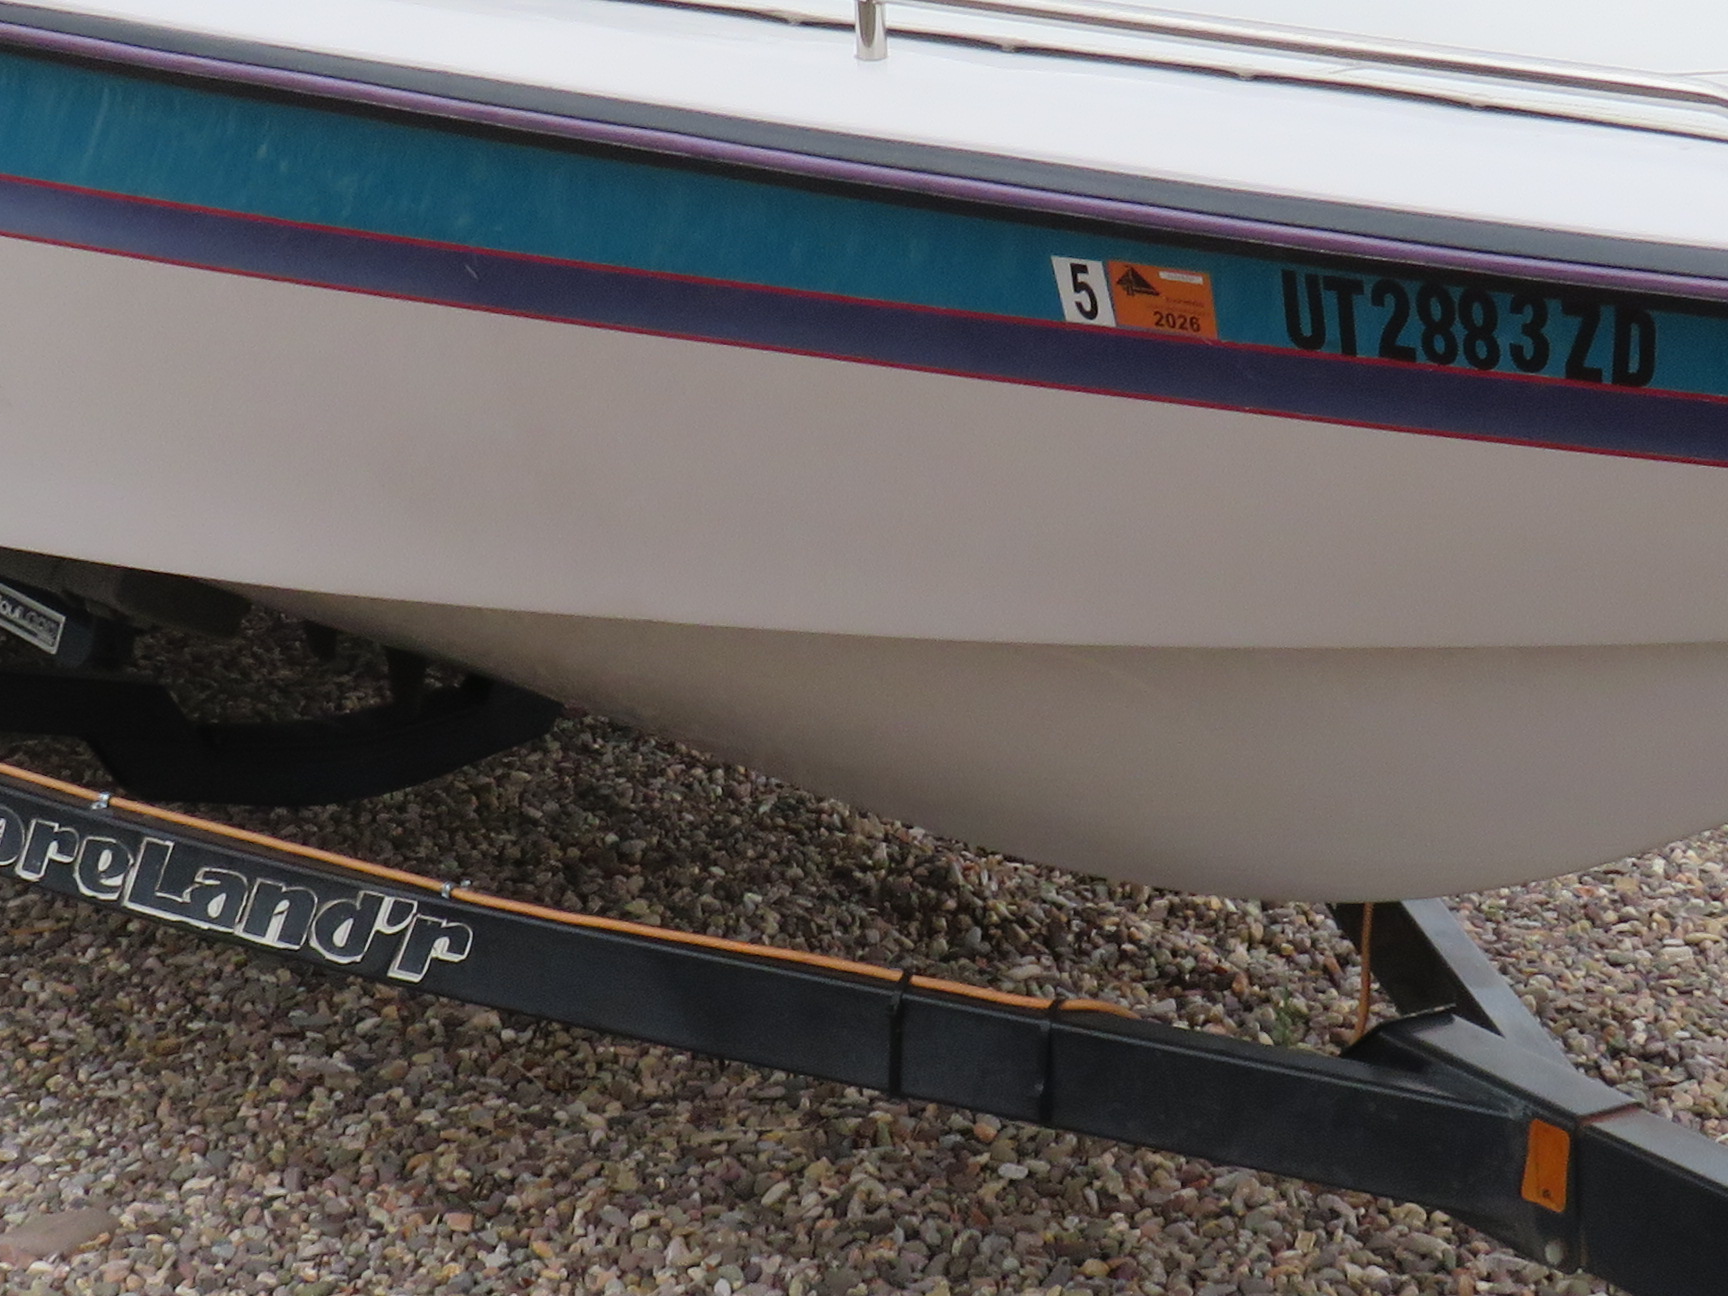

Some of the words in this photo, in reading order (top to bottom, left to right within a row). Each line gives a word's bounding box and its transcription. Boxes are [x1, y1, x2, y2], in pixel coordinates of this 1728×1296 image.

[1070, 262, 1099, 320] 5
[1153, 311, 1201, 333] 2026
[1281, 268, 1658, 388] UT2883ZD
